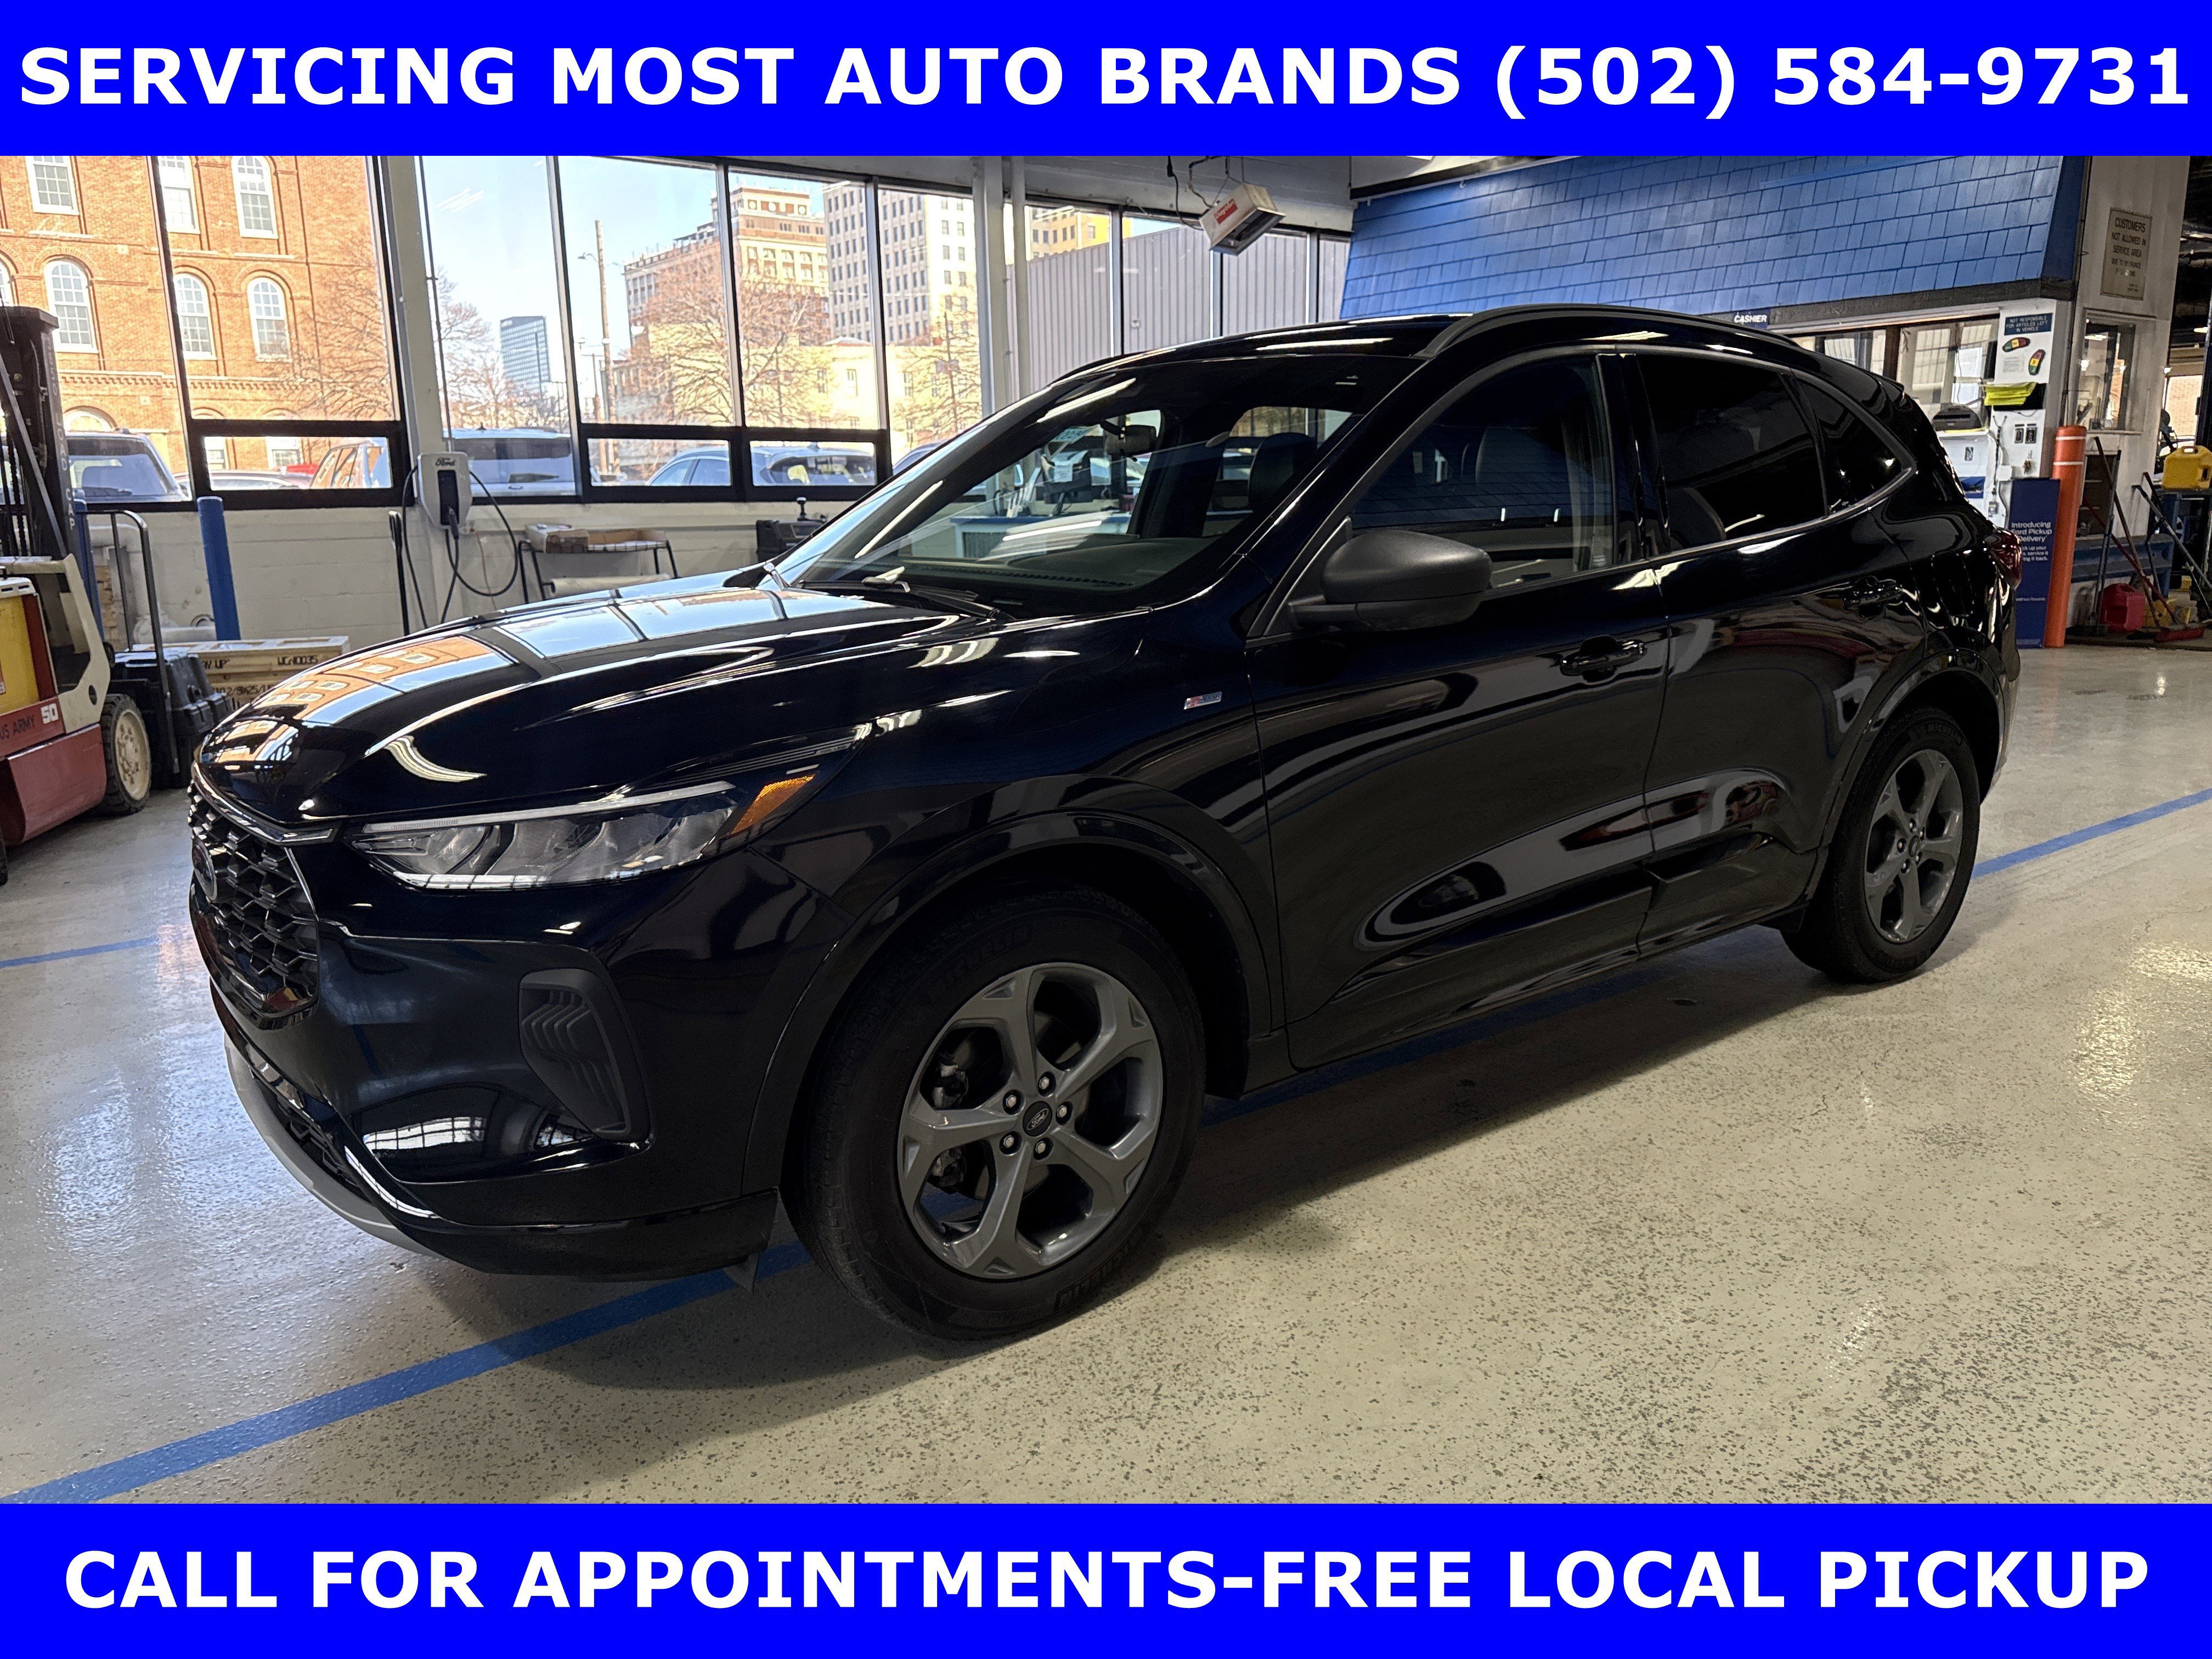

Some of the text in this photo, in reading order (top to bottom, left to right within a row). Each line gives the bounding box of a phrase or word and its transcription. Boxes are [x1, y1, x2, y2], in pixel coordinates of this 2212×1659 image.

[2115, 217, 2146, 233] CUSTOMERS
[2112, 232, 2120, 241] NOT
[2121, 234, 2140, 245] ALLOWED
[2113, 245, 2142, 258] SERVICE AREA
[1734, 315, 1767, 323] CASHIER
[436, 458, 455, 466] Ford
[55, 413, 67, 471] LOAD
[66, 488, 76, 531] CAP
[13, 714, 35, 736] ARMY
[41, 703, 59, 724] 50
